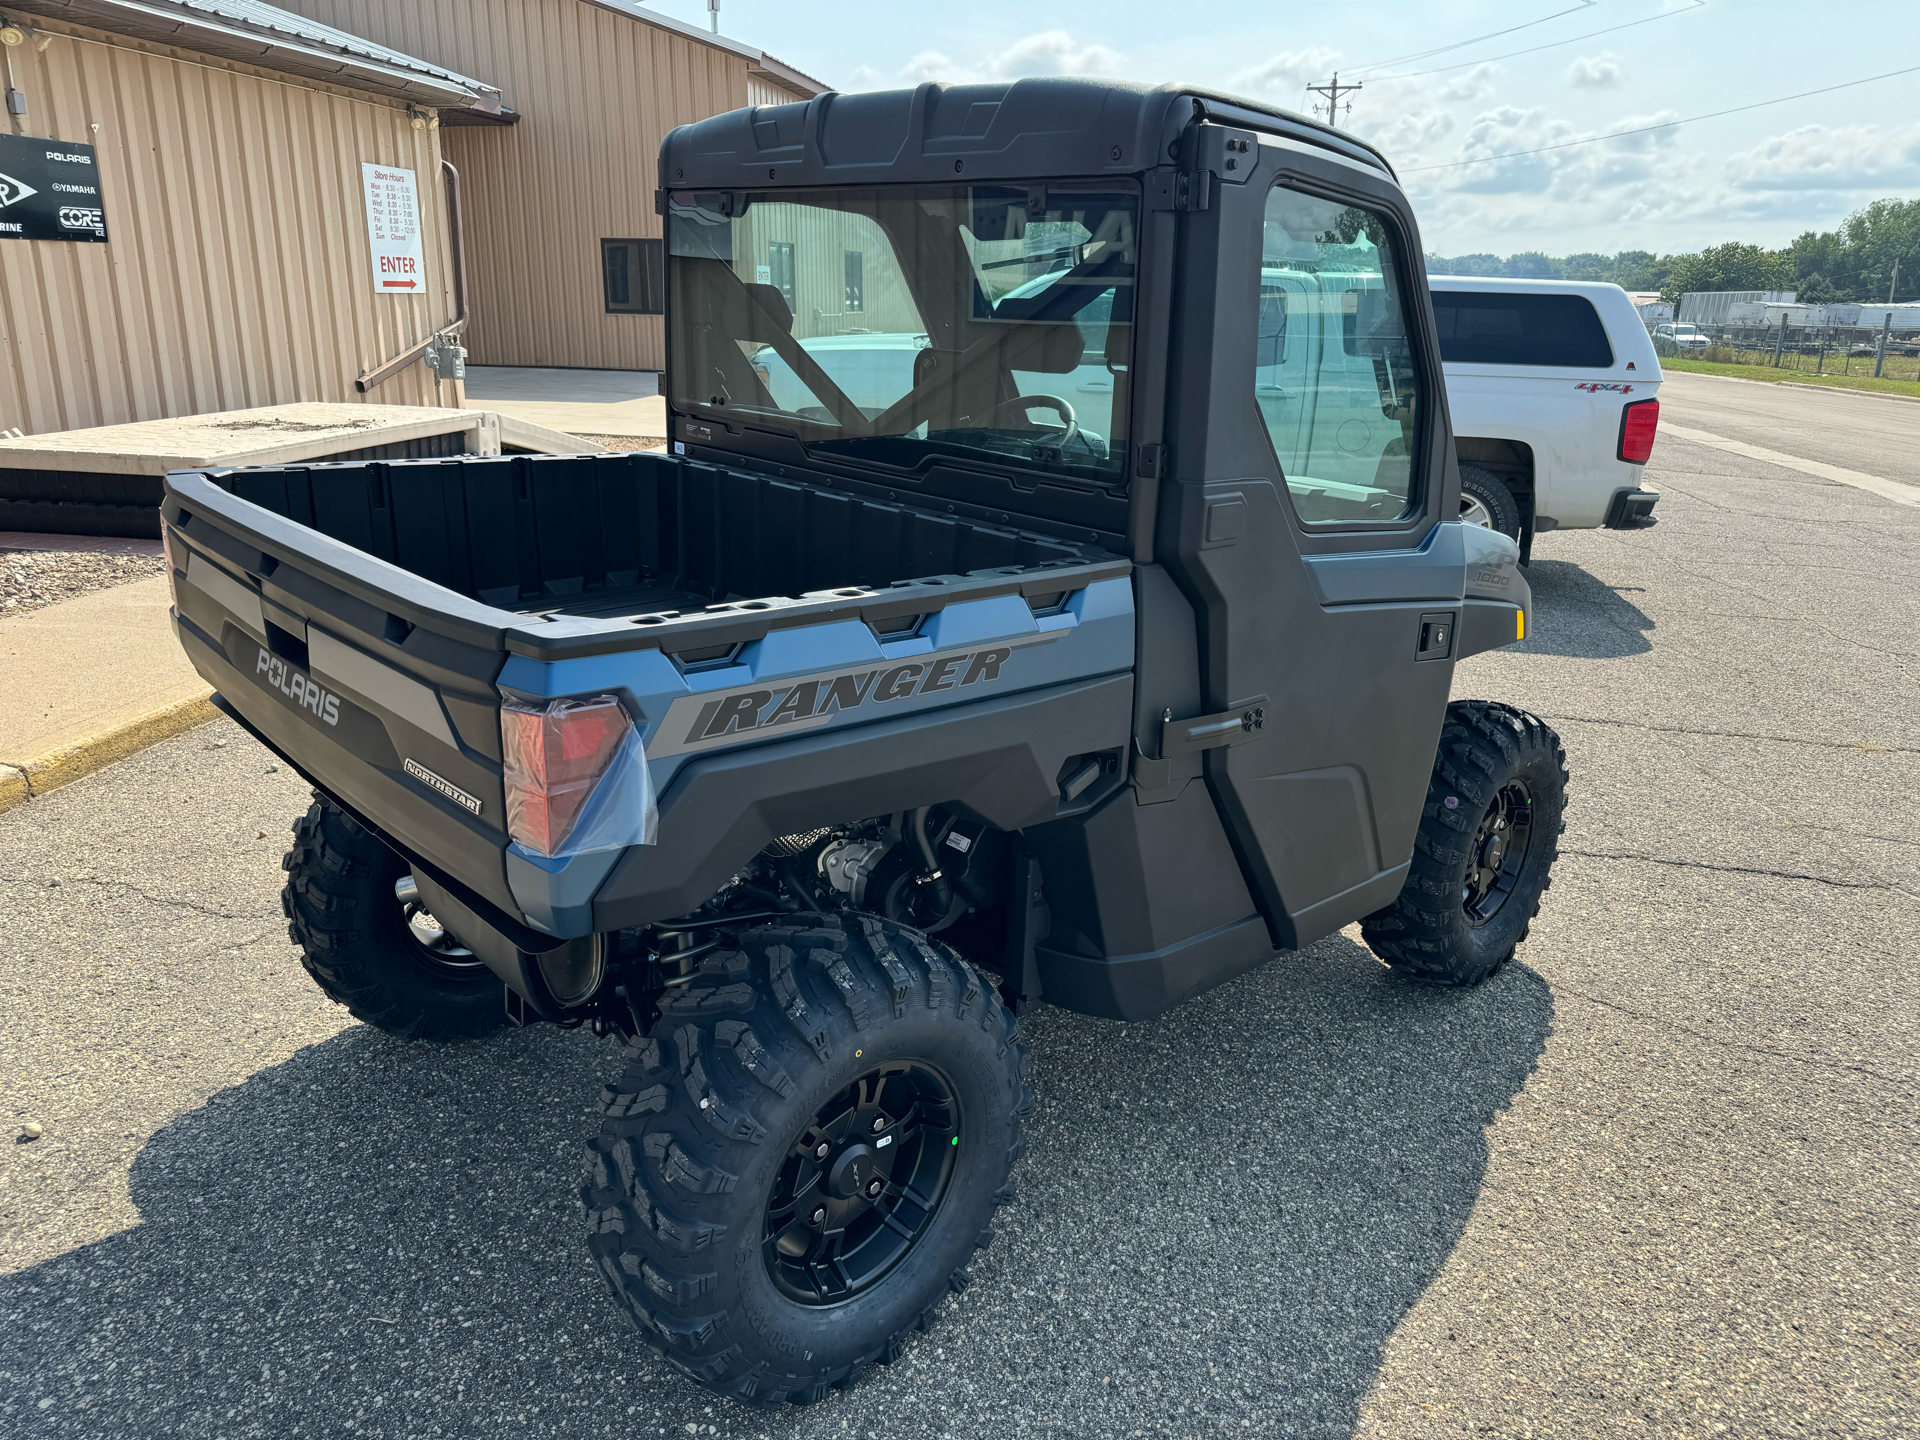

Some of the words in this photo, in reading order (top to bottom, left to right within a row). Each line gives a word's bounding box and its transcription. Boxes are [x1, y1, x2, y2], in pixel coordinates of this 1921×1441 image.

[46, 152, 91, 164] POLARIS
[374, 170, 388, 180] Store
[389, 173, 405, 182] Hours
[61, 183, 96, 195] YAMAHA
[370, 182, 381, 190] Mon
[372, 199, 382, 207] Wed
[373, 207, 384, 215] Thur
[59, 208, 104, 228] CORE
[375, 224, 383, 232] Sat
[376, 232, 385, 240] Sun
[391, 233, 406, 241] Closed
[380, 256, 416, 274] ENTER
[1464, 543, 1516, 574] XP
[256, 648, 340, 726] POLARIS
[700, 647, 1012, 738] RANGER
[407, 762, 476, 811] NORTHSTAR
[852, 1162, 860, 1187] XP
